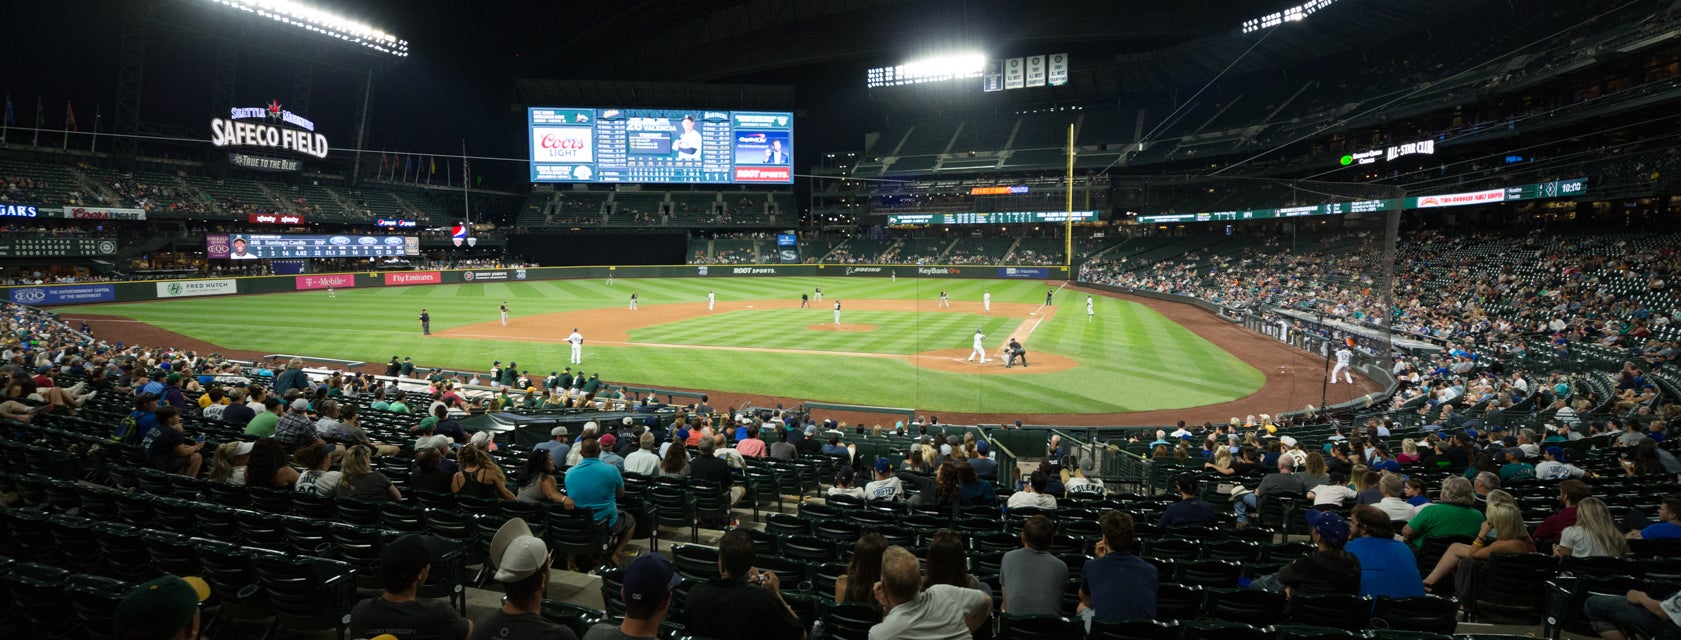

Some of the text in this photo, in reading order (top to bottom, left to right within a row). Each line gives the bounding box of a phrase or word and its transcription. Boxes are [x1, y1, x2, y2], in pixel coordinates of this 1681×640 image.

[231, 107, 266, 119] SEATTLE
[212, 118, 328, 158] SAFECO FIELD
[540, 133, 584, 150] Coors
[1417, 140, 1434, 154] CLUB
[242, 156, 296, 170] TRUE TO THE BLUE
[1562, 183, 1581, 192] 10:00
[72, 208, 109, 219] Coors
[15, 291, 45, 300] EQC
